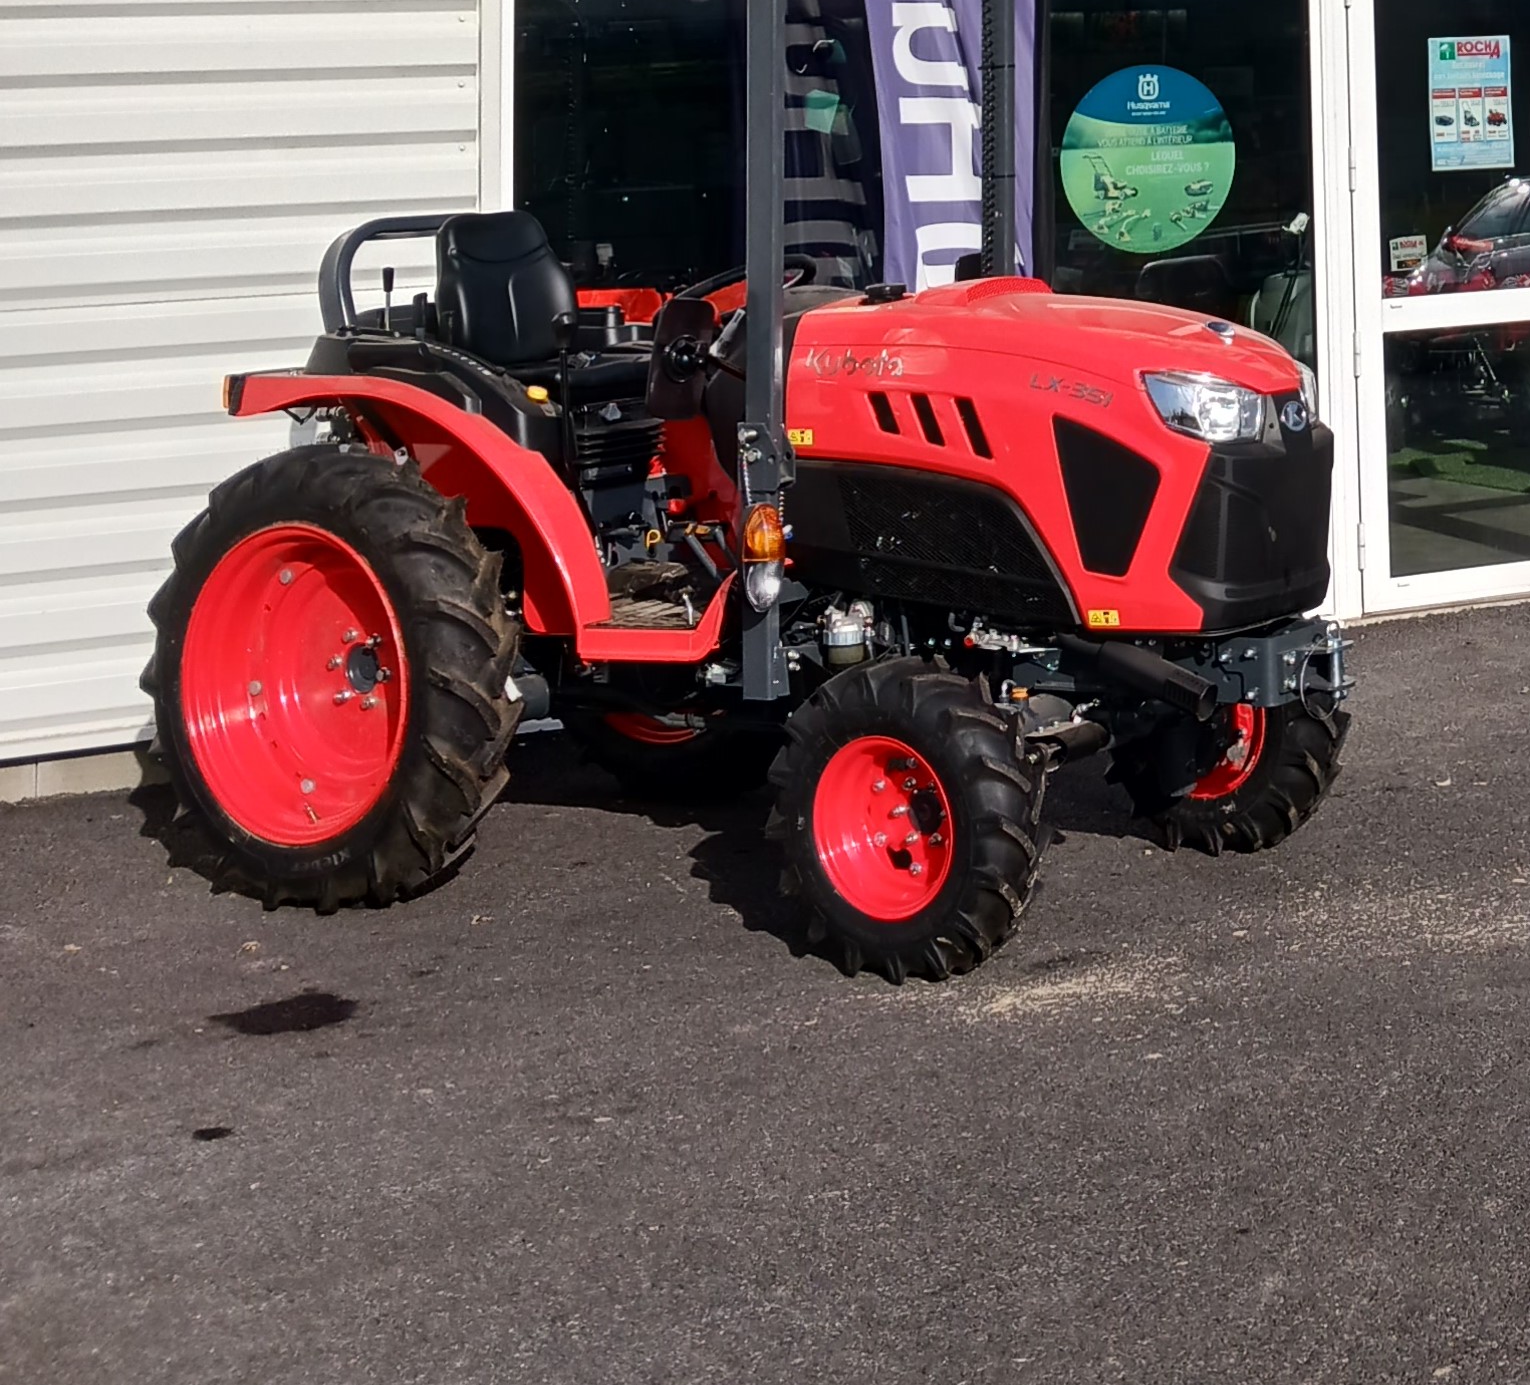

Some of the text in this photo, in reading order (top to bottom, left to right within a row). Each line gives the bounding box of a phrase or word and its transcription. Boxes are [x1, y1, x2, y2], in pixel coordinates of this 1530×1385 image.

[1456, 40, 1501, 59] ROCHA
[1127, 101, 1171, 110] Husqvarna
[1151, 151, 1184, 161] LEQUEL
[805, 348, 905, 377] Kubota
[1029, 372, 1114, 408] LX-351
